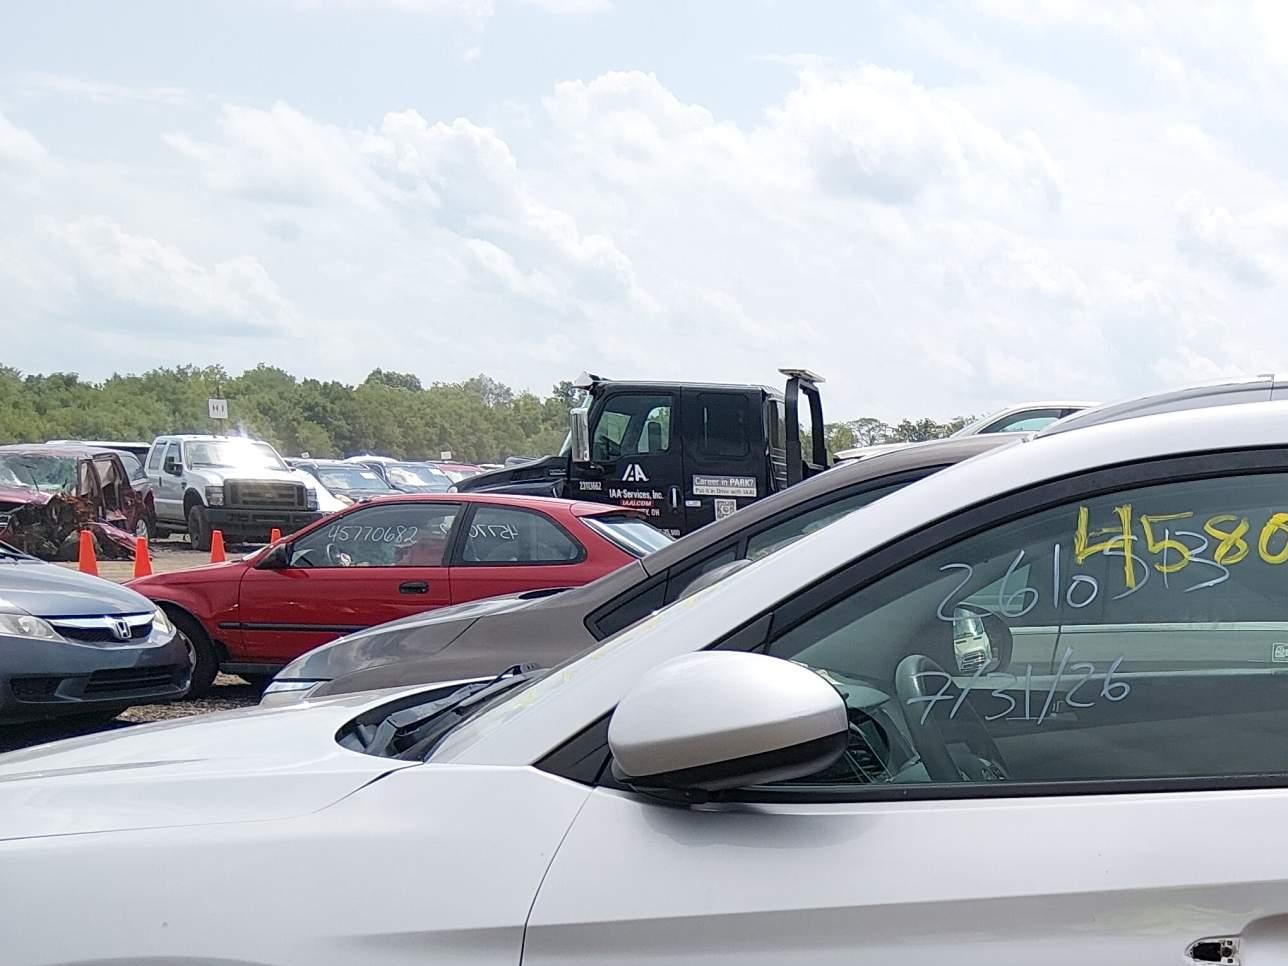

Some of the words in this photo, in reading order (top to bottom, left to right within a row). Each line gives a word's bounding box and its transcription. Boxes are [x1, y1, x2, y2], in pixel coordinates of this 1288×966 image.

[695, 477, 719, 486] Career
[729, 478, 754, 487] PARK?
[609, 489, 622, 498] IAA
[623, 489, 652, 500] Services,
[652, 489, 664, 500] Inc.
[328, 525, 418, 544] 45770682
